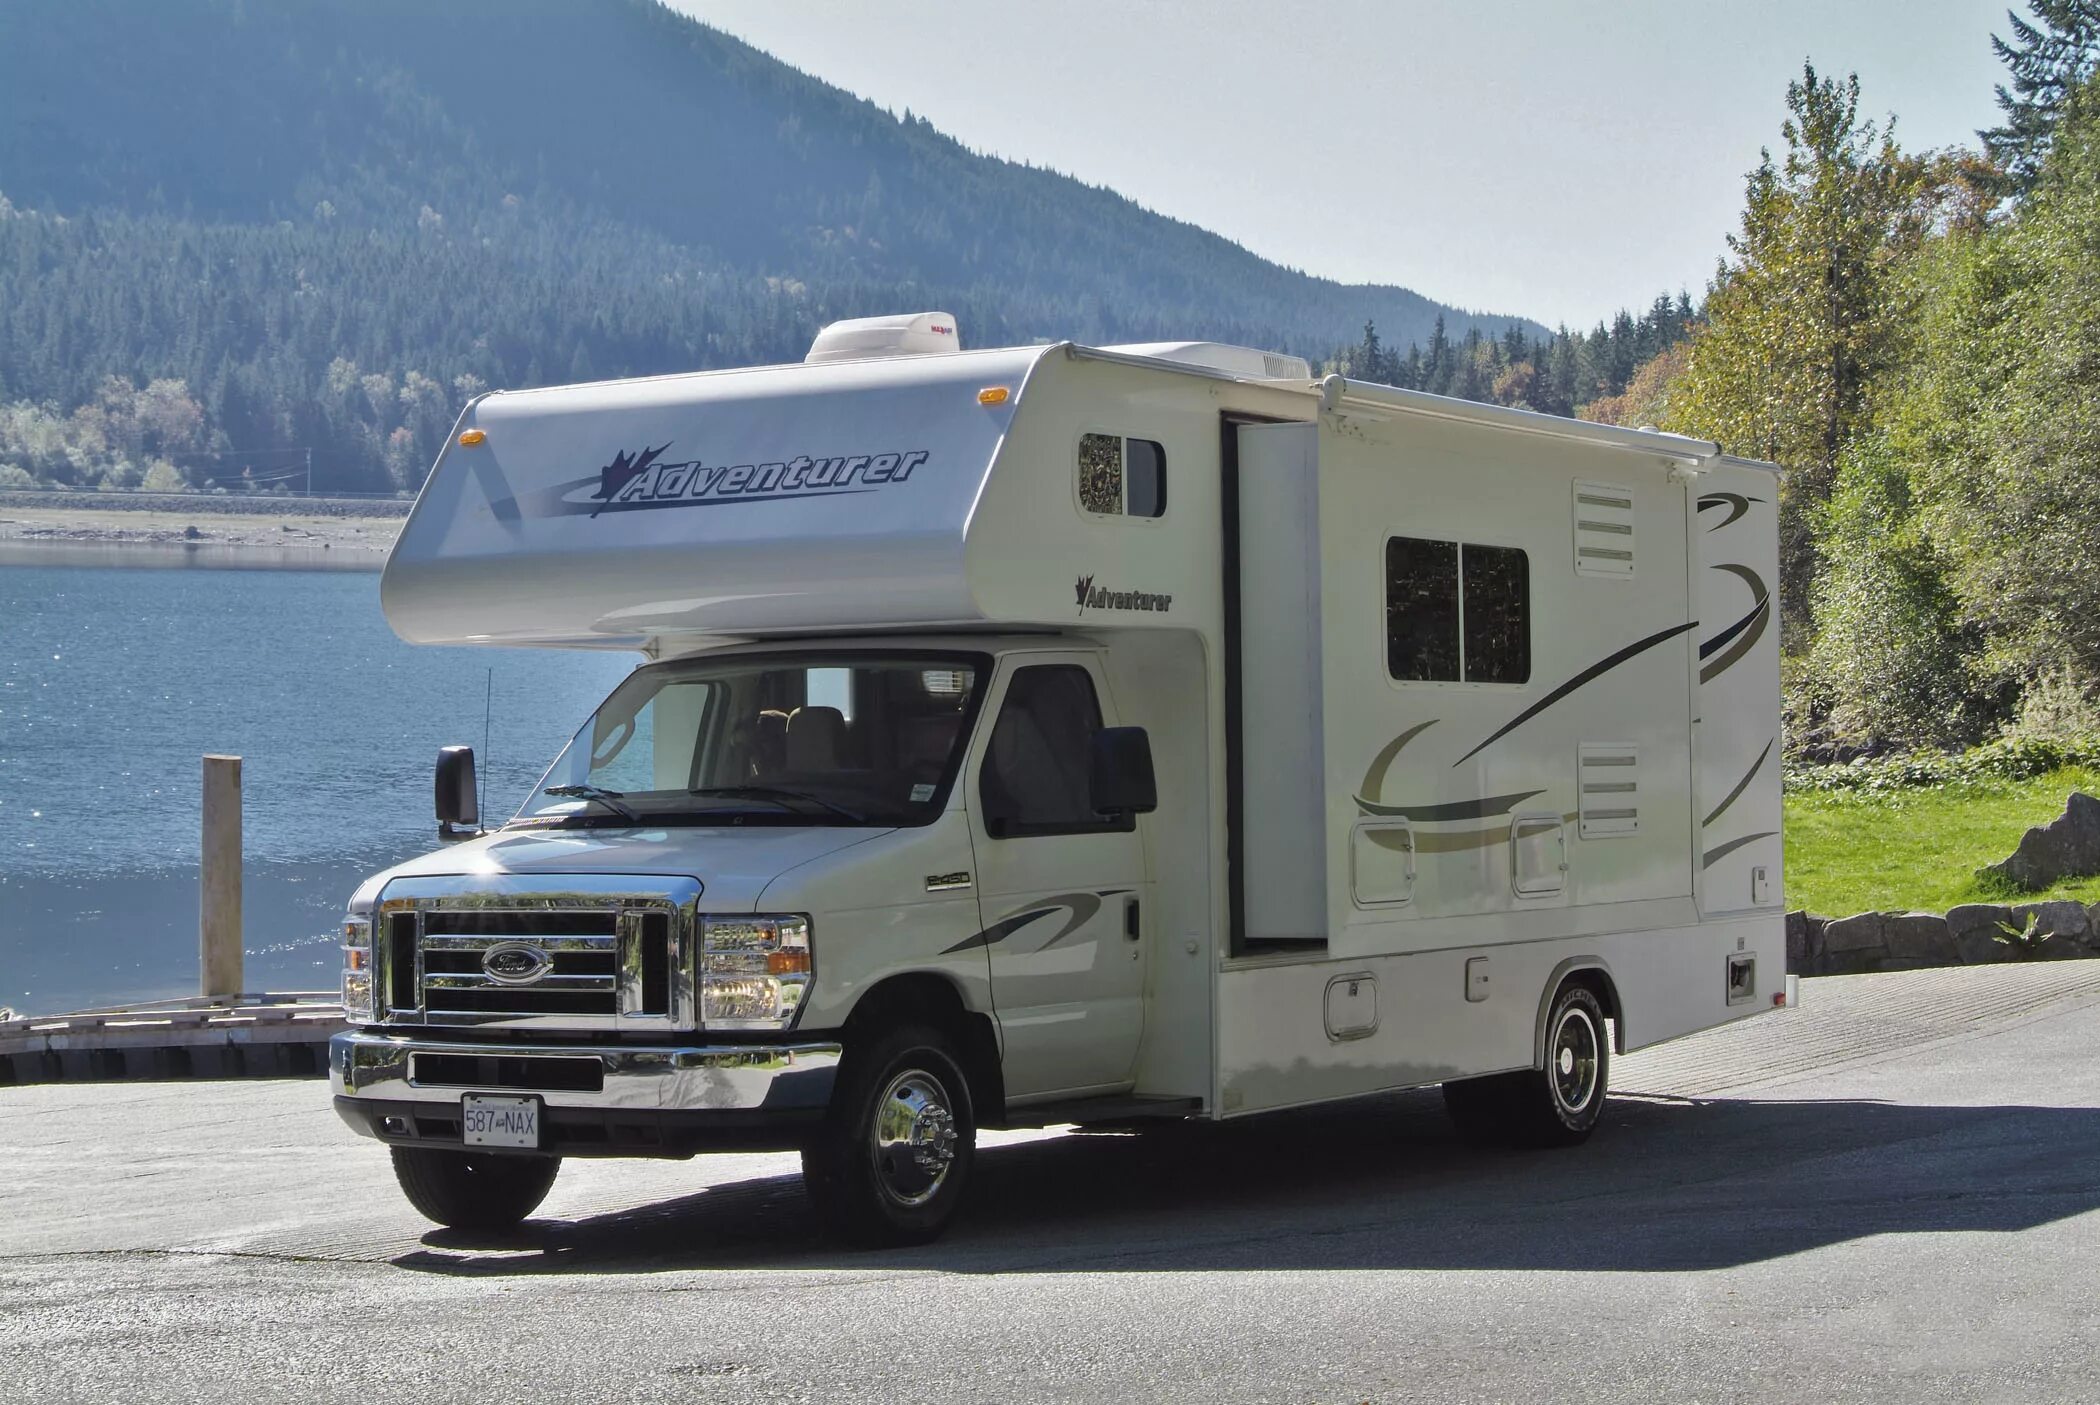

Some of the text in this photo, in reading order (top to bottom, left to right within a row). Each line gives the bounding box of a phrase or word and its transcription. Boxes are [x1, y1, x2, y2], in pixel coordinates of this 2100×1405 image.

[618, 450, 929, 502] Adventurer
[1085, 586, 1172, 612] Adventurer
[497, 954, 526, 971] Ford
